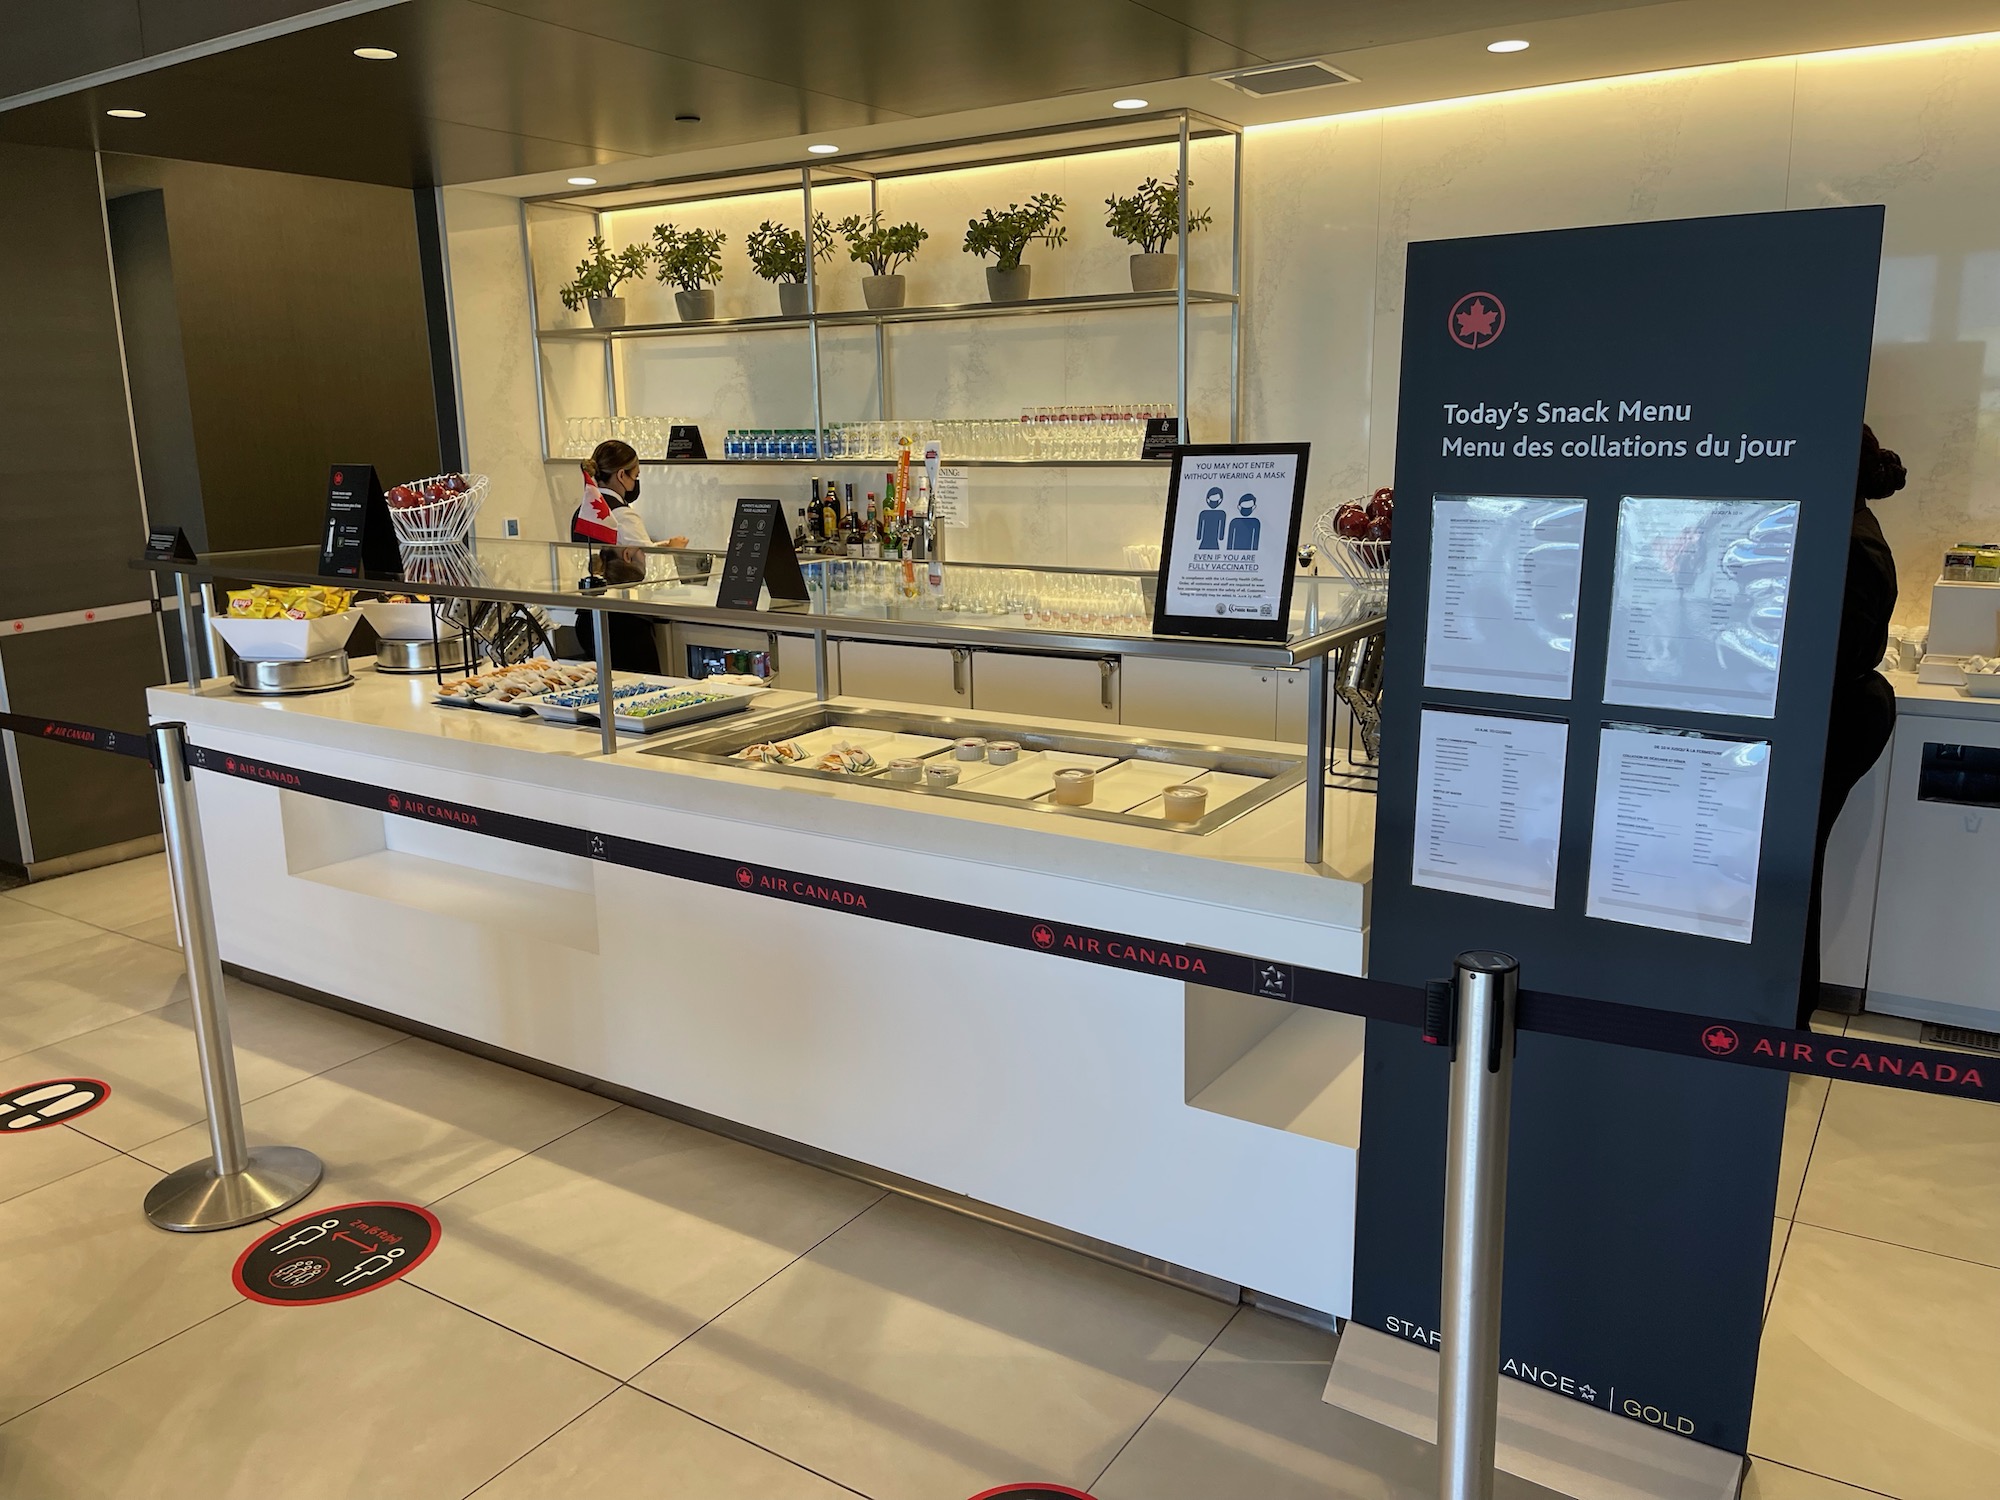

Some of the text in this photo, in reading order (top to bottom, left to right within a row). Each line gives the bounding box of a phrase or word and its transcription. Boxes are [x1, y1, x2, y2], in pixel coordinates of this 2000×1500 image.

[1444, 400, 1692, 430] Today’s Snack Menu
[1441, 434, 1796, 464] Menu des collations du jour
[939, 468, 960, 476] NING:
[1213, 462, 1231, 470] MAY
[1263, 471, 1286, 479] MASK
[1211, 563, 1259, 571] VACCINATED
[53, 727, 95, 742] AIR CANADA
[239, 763, 300, 786] AIR CANADA
[404, 800, 478, 827] AIR CANADA
[760, 876, 868, 908] AIR CANADA
[1063, 935, 1208, 974] AIR CANADA
[1753, 1038, 1983, 1088] AIR CANADA
[1502, 1358, 1575, 1395] ANCE
[1623, 1399, 1695, 1435] GOLD
